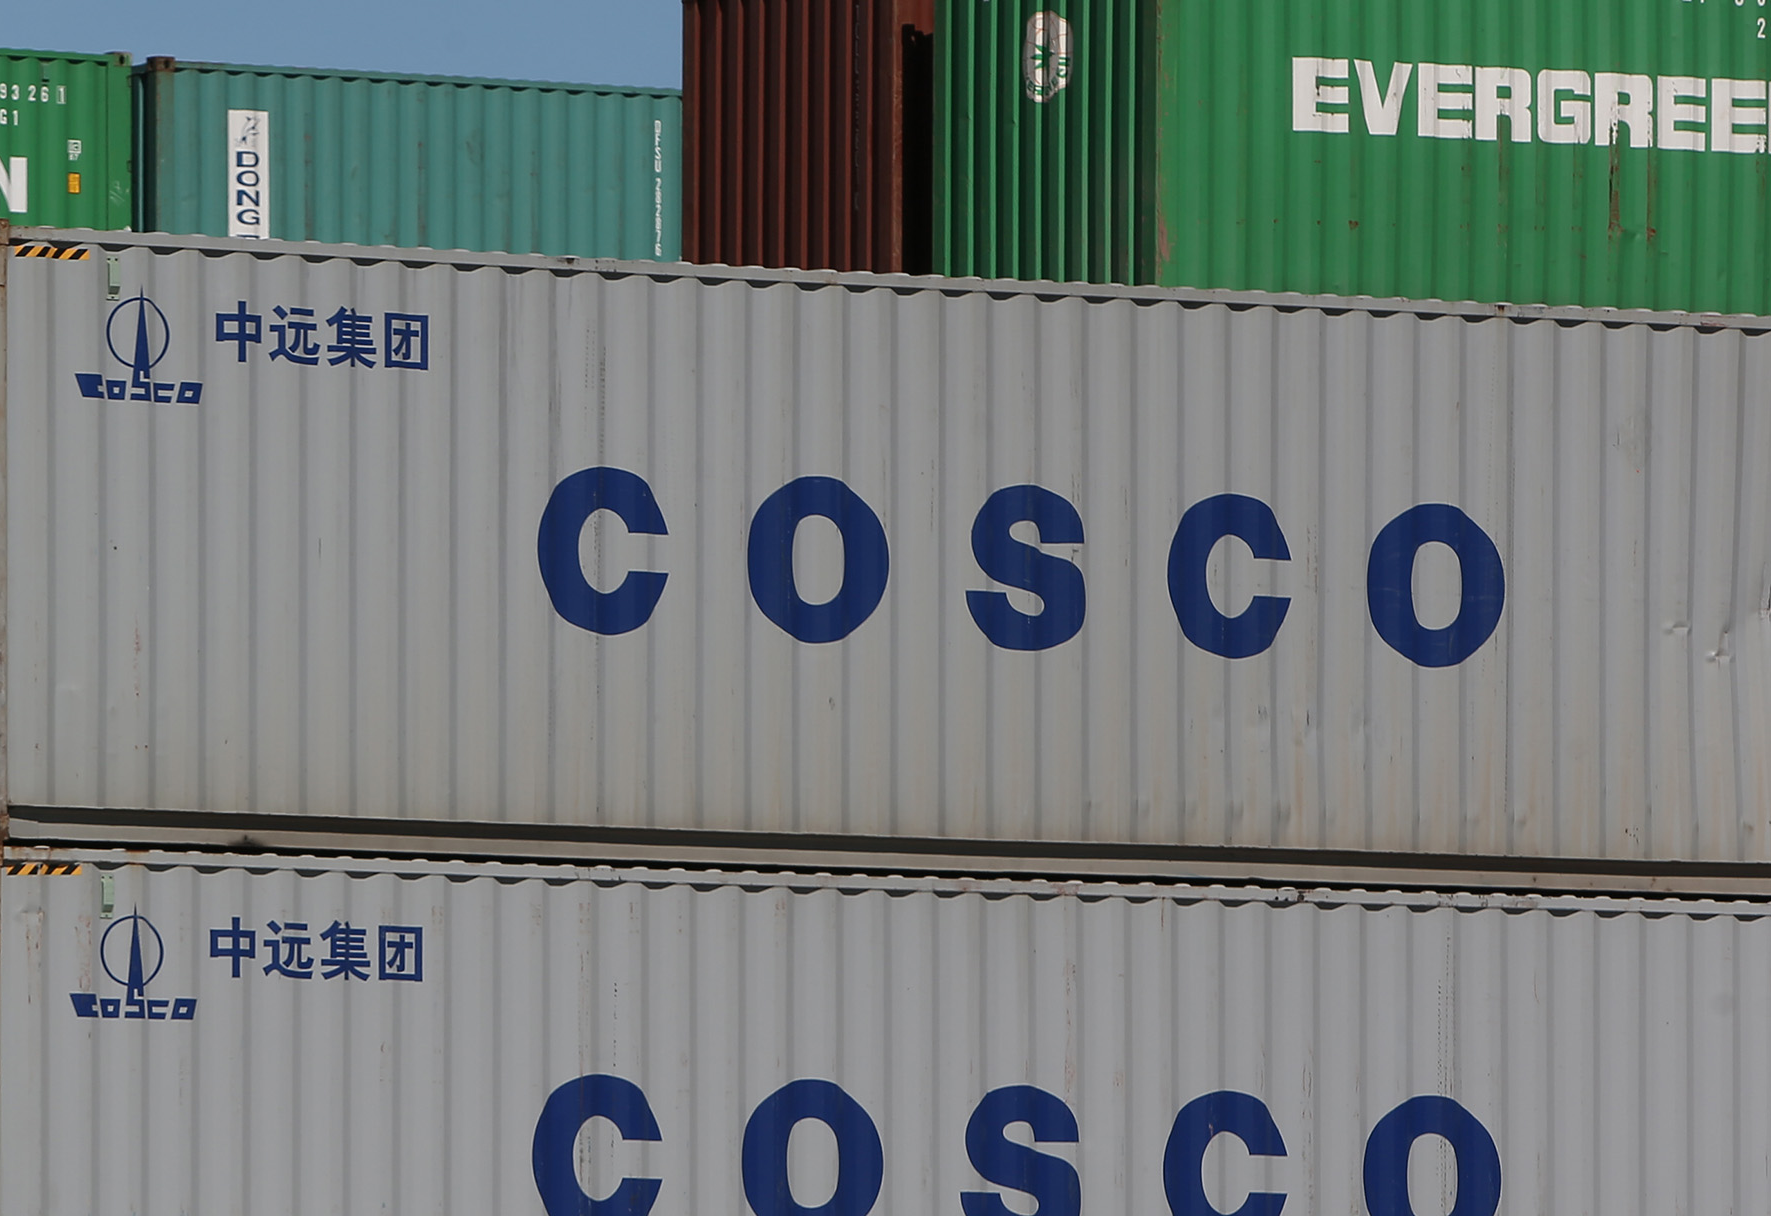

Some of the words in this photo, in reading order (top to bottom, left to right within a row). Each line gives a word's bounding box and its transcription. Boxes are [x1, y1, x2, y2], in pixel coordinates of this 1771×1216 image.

[1292, 57, 1771, 154] EVERGREE
[236, 151, 260, 226] DONG
[215, 300, 429, 371] 中远集团
[74, 372, 203, 404] COSCO
[539, 467, 1505, 667] COSCO
[209, 916, 424, 982] 中远集团
[69, 992, 197, 1020] COSCO
